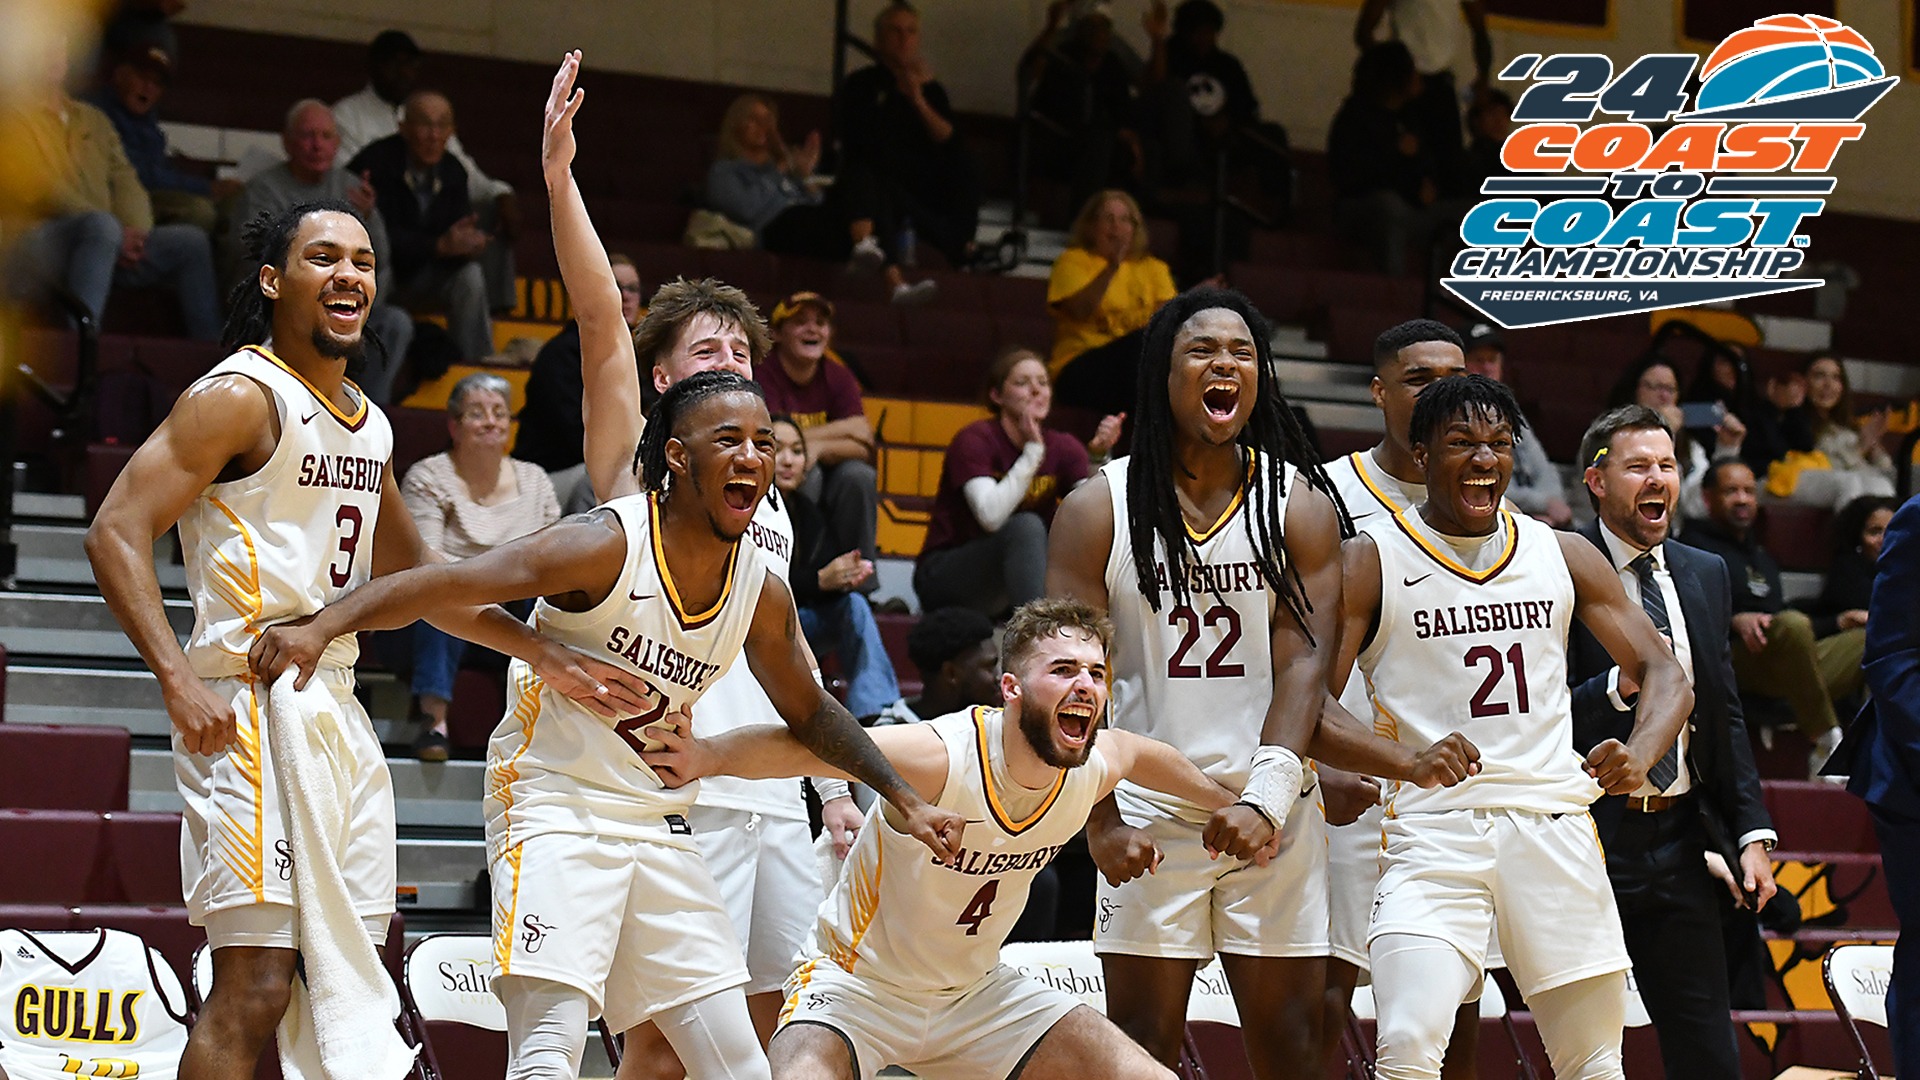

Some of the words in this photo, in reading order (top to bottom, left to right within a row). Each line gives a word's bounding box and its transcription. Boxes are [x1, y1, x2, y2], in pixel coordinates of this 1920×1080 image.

[329, 504, 363, 588] 3
[749, 520, 788, 563] BURY
[1168, 605, 1245, 678] 22
[1413, 600, 1554, 640] SALISBURY
[1463, 642, 1530, 718] 21
[613, 679, 670, 753] 2
[955, 879, 1001, 936] 4
[14, 983, 146, 1044] GULLS
